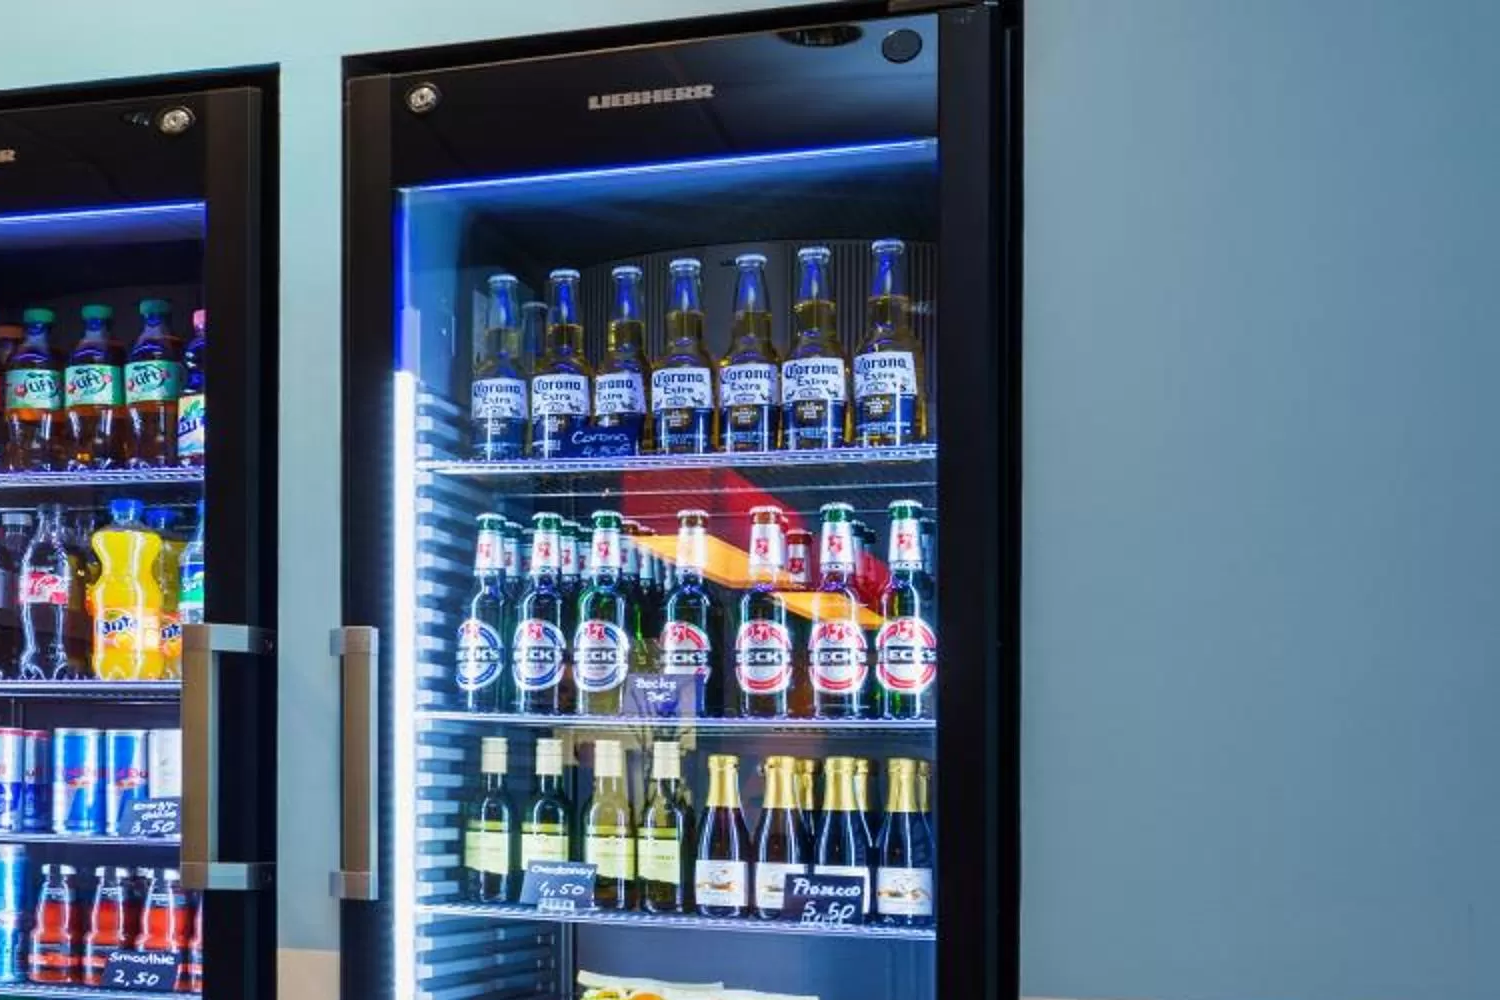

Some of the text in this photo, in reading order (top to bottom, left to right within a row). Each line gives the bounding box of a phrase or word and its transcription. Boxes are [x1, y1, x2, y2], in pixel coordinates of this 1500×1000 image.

[588, 84, 715, 110] LIEBHERR
[785, 363, 839, 379] Corona
[856, 356, 907, 373] Corona
[654, 369, 704, 386] Corona
[720, 368, 771, 384] Corona
[597, 378, 634, 391] orona
[602, 391, 624, 401] xtra
[109, 952, 175, 965] Smoothie
[113, 969, 160, 987] 2,50
